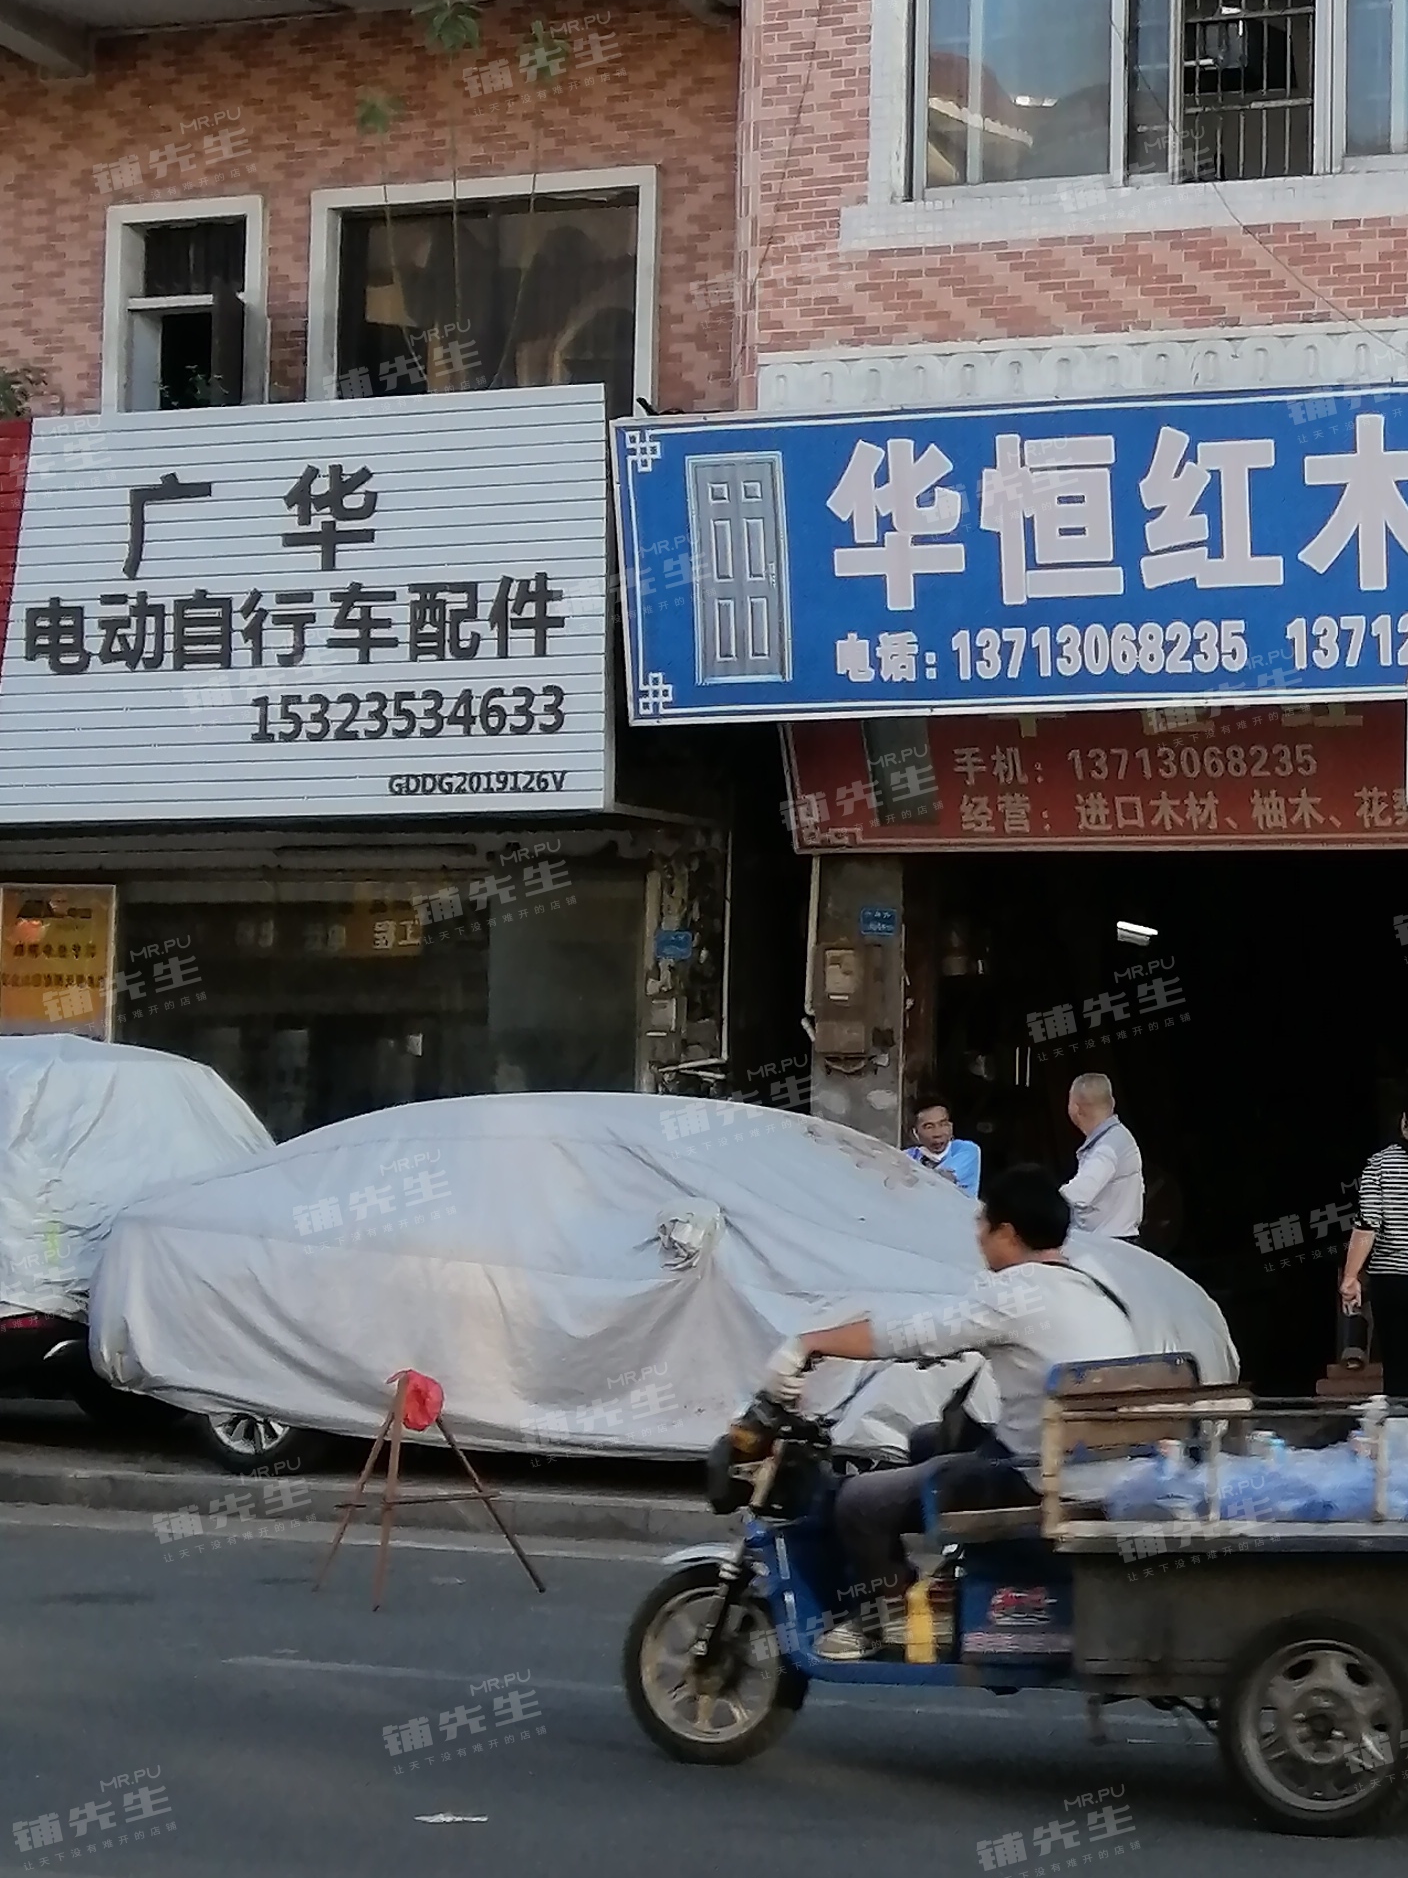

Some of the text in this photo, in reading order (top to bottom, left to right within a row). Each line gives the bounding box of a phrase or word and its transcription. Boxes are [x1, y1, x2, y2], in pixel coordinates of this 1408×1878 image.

[122, 463, 378, 579] 广华
[23, 571, 566, 676] 电动自行车配件
[250, 684, 567, 744] 15323534633
